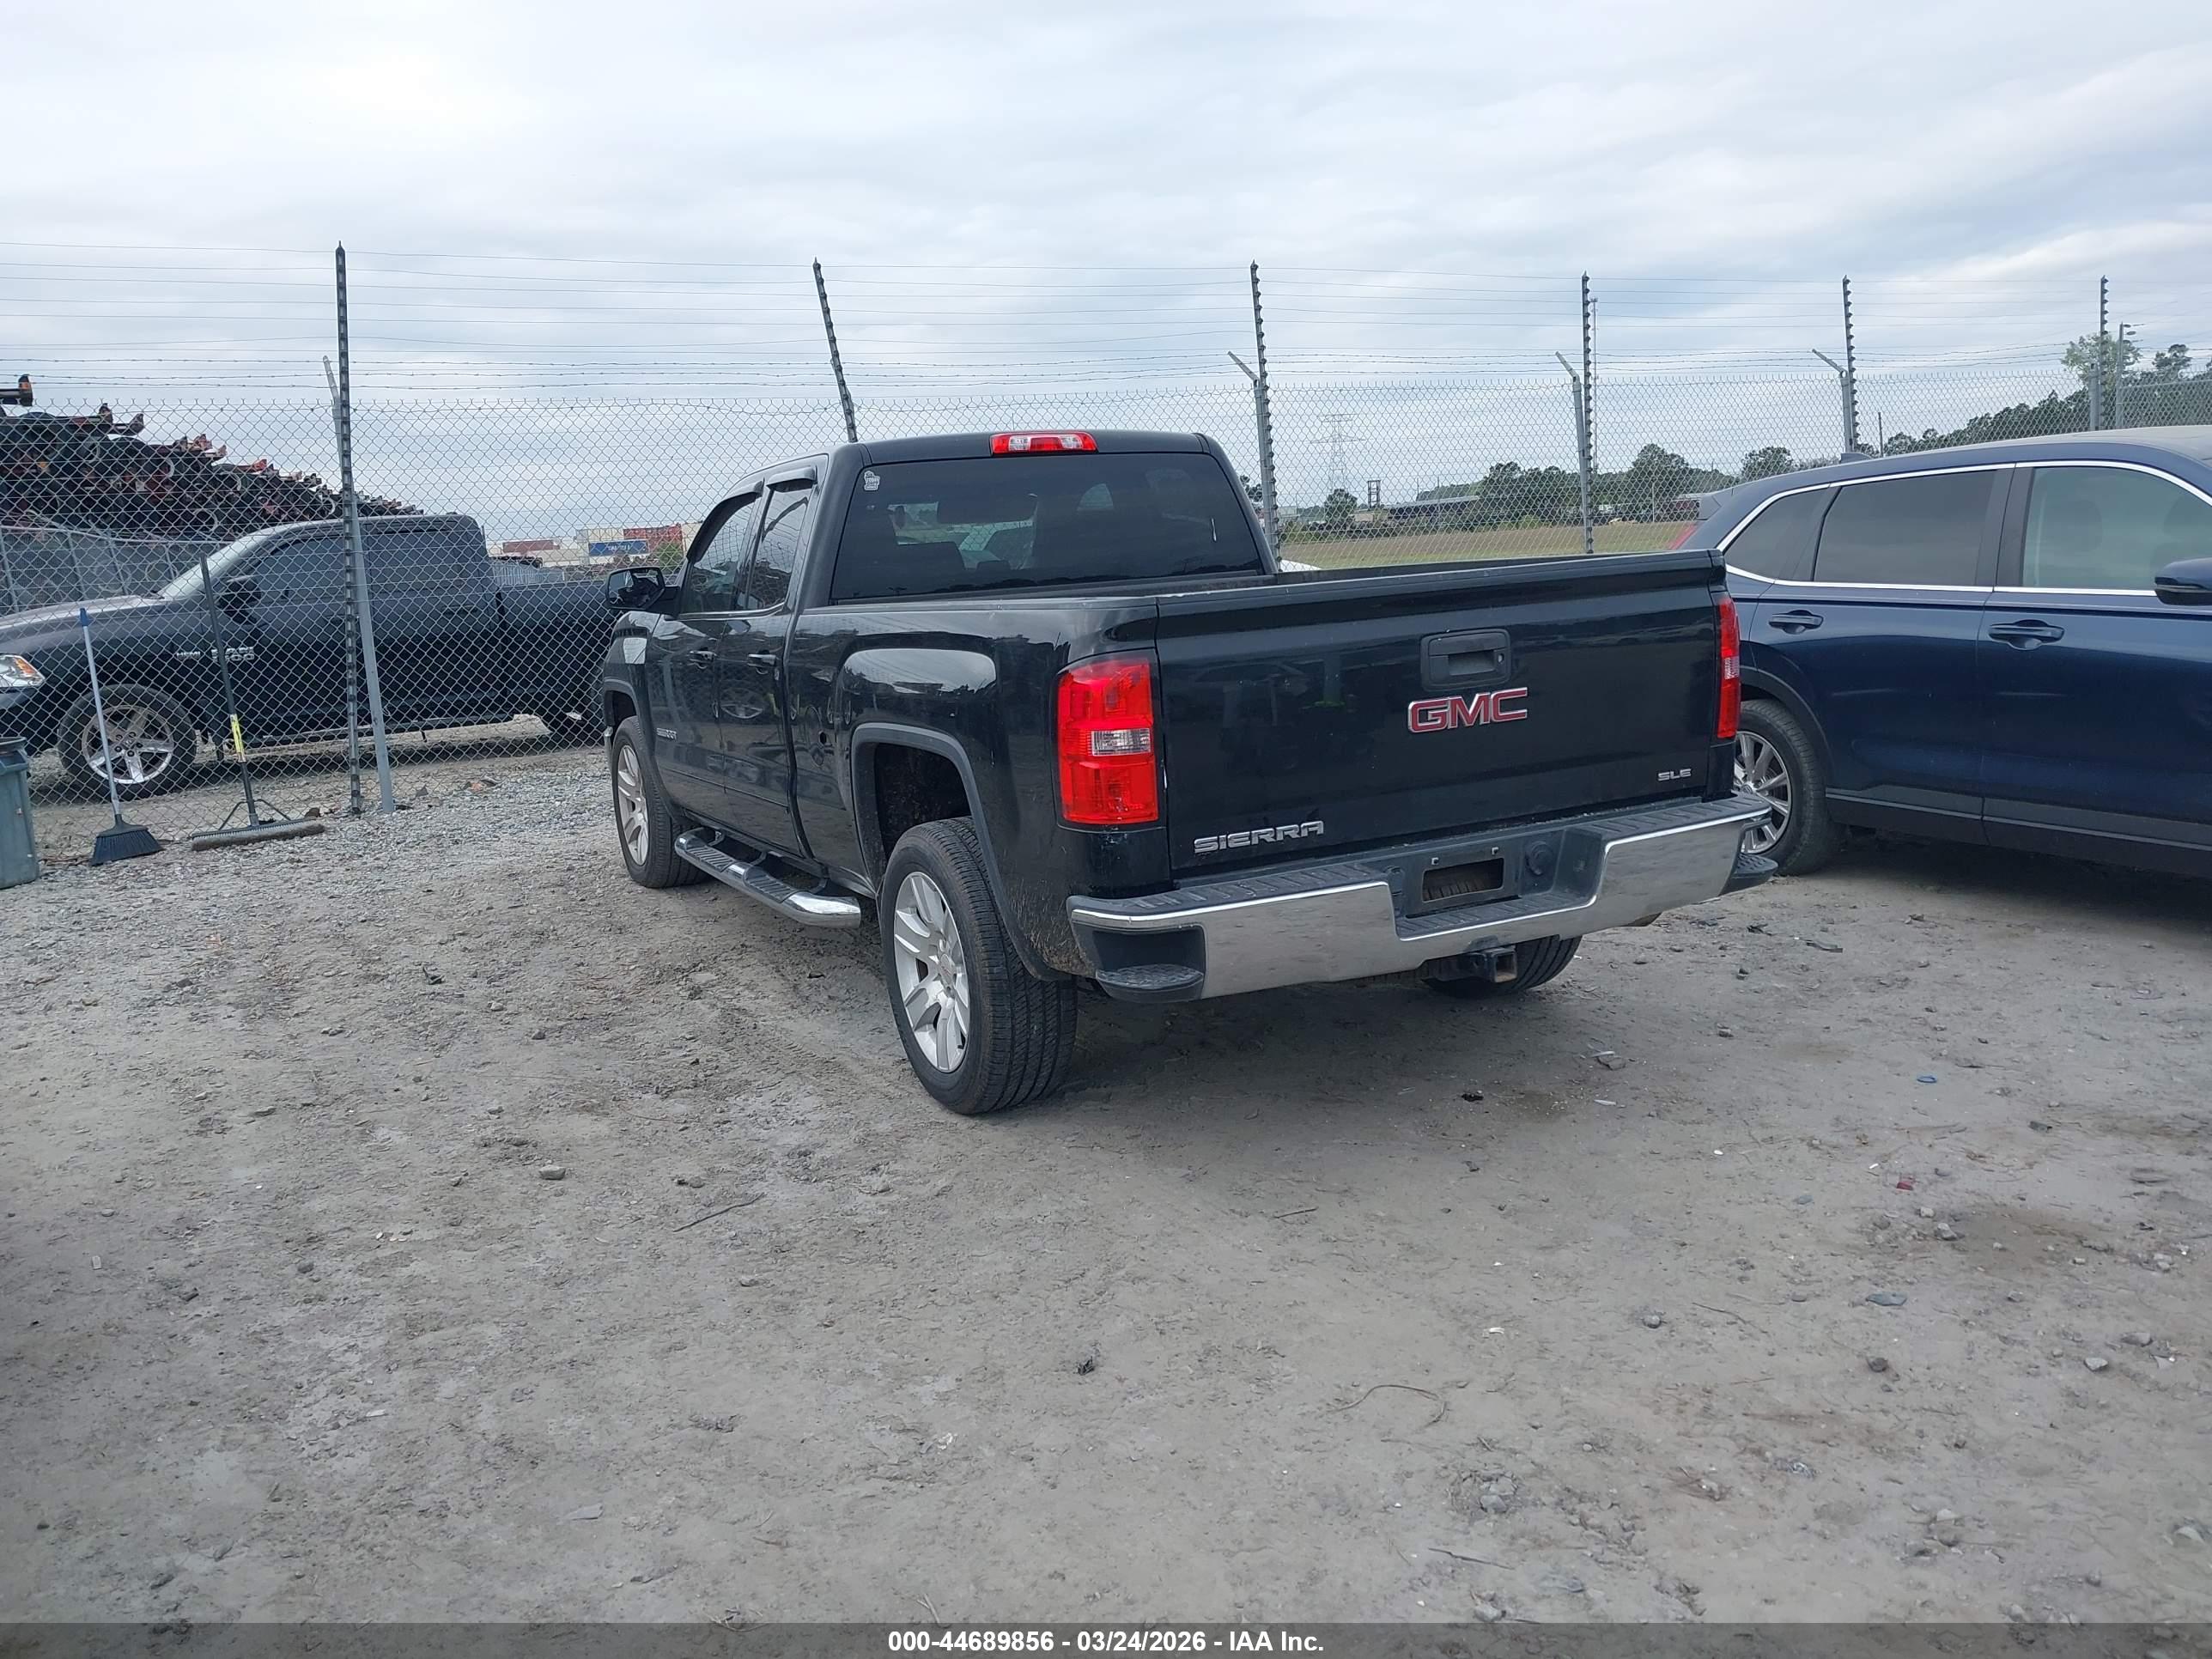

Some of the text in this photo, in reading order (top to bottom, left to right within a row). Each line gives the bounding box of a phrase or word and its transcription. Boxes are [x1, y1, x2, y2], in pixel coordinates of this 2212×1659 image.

[1408, 687, 1528, 733] GMC
[1657, 769, 1692, 781] SLE
[1194, 820, 1324, 854] SIERRA
